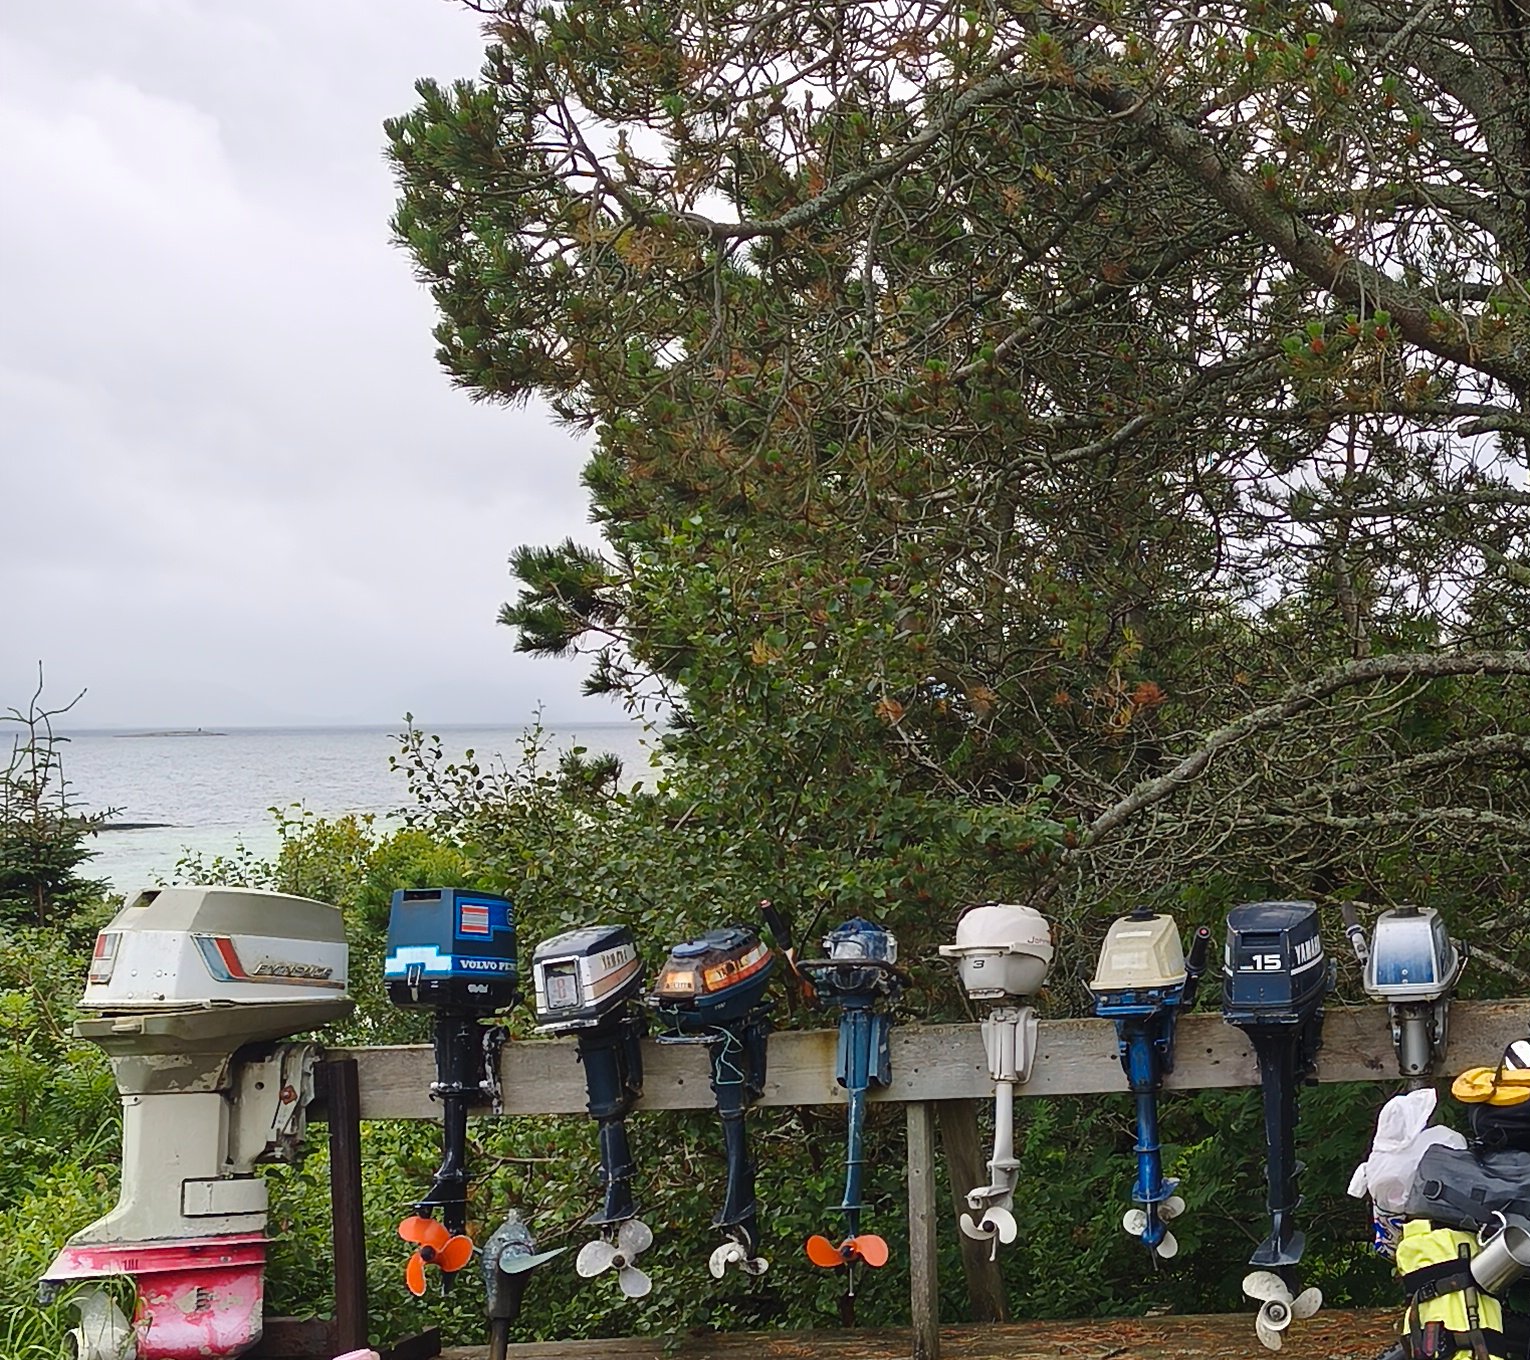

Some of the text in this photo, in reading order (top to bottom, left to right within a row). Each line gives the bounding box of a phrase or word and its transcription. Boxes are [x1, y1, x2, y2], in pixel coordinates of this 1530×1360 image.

[459, 959, 497, 971] VOLVO
[972, 959, 985, 969] 3
[1251, 953, 1282, 970] 15
